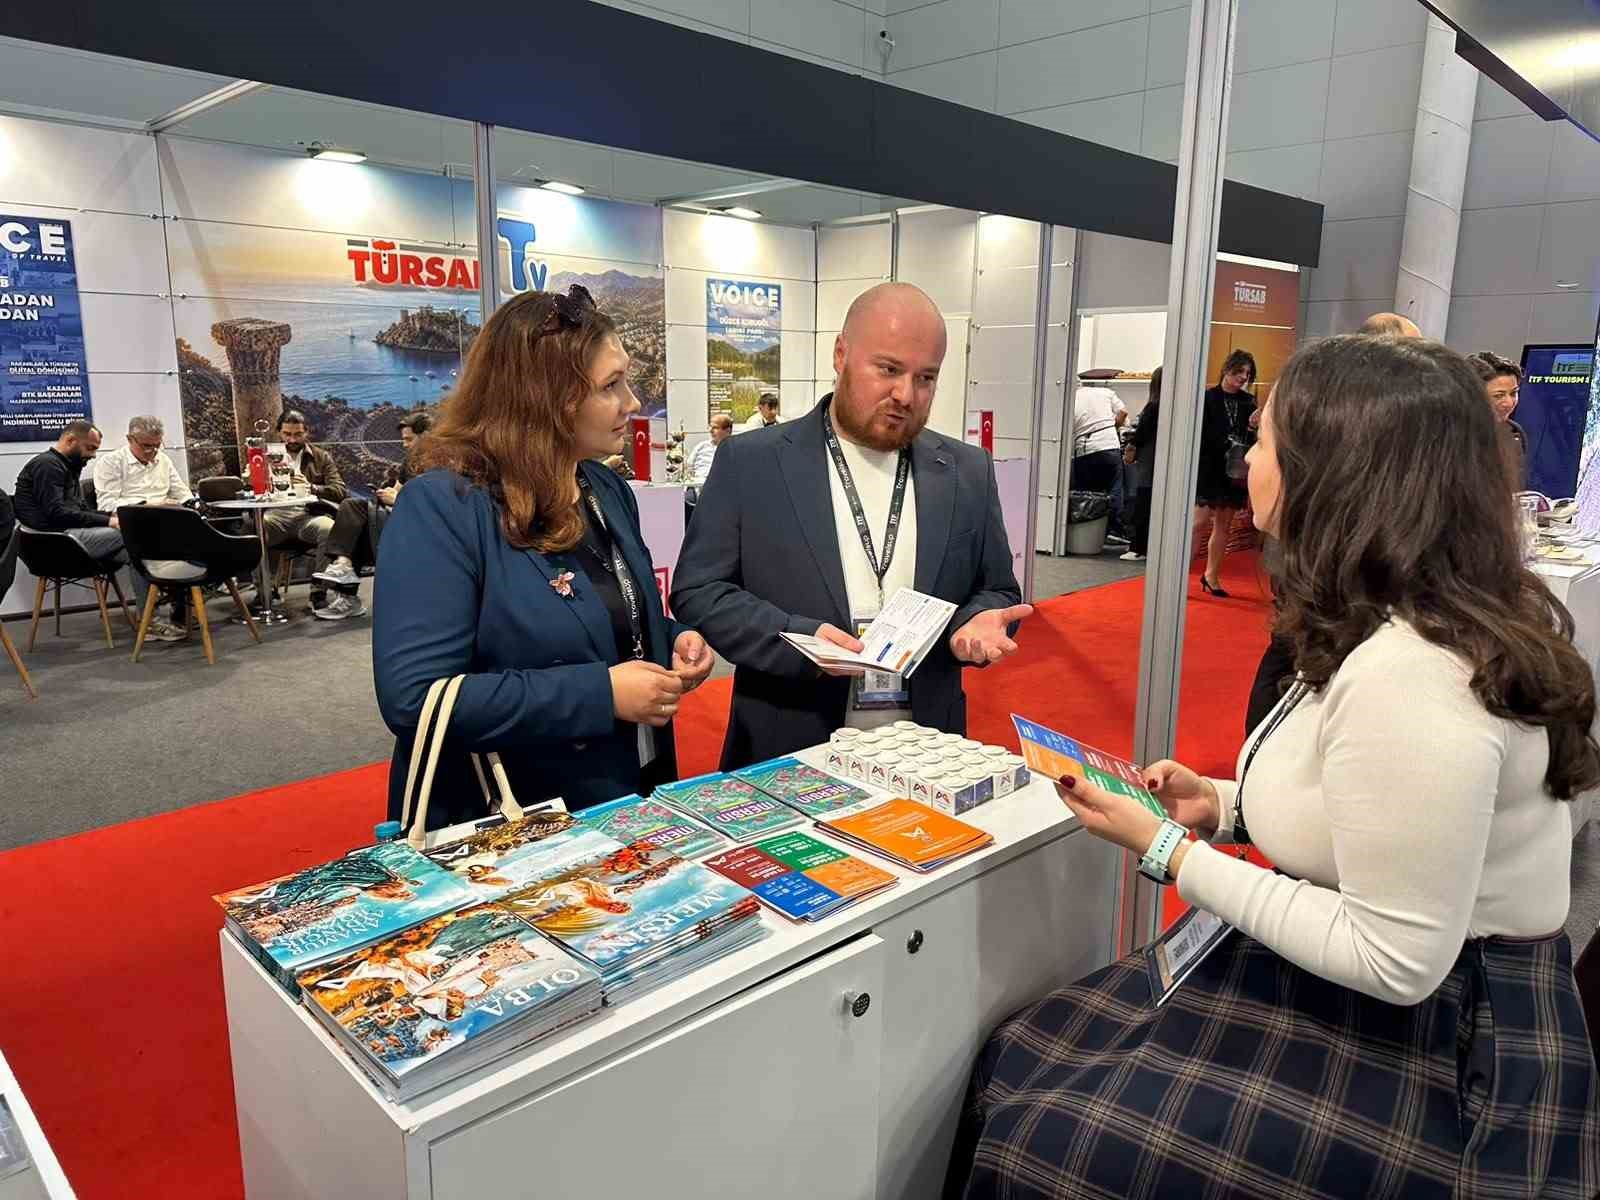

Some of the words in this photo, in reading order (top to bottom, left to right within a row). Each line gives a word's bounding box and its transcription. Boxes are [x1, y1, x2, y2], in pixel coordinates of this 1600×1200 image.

[30, 254, 67, 262] TRAVEL
[347, 241, 480, 289] TÜRSA
[710, 283, 779, 307] VOICE
[1544, 376, 1585, 384] TOURISM
[477, 968, 580, 1017] OLBA
